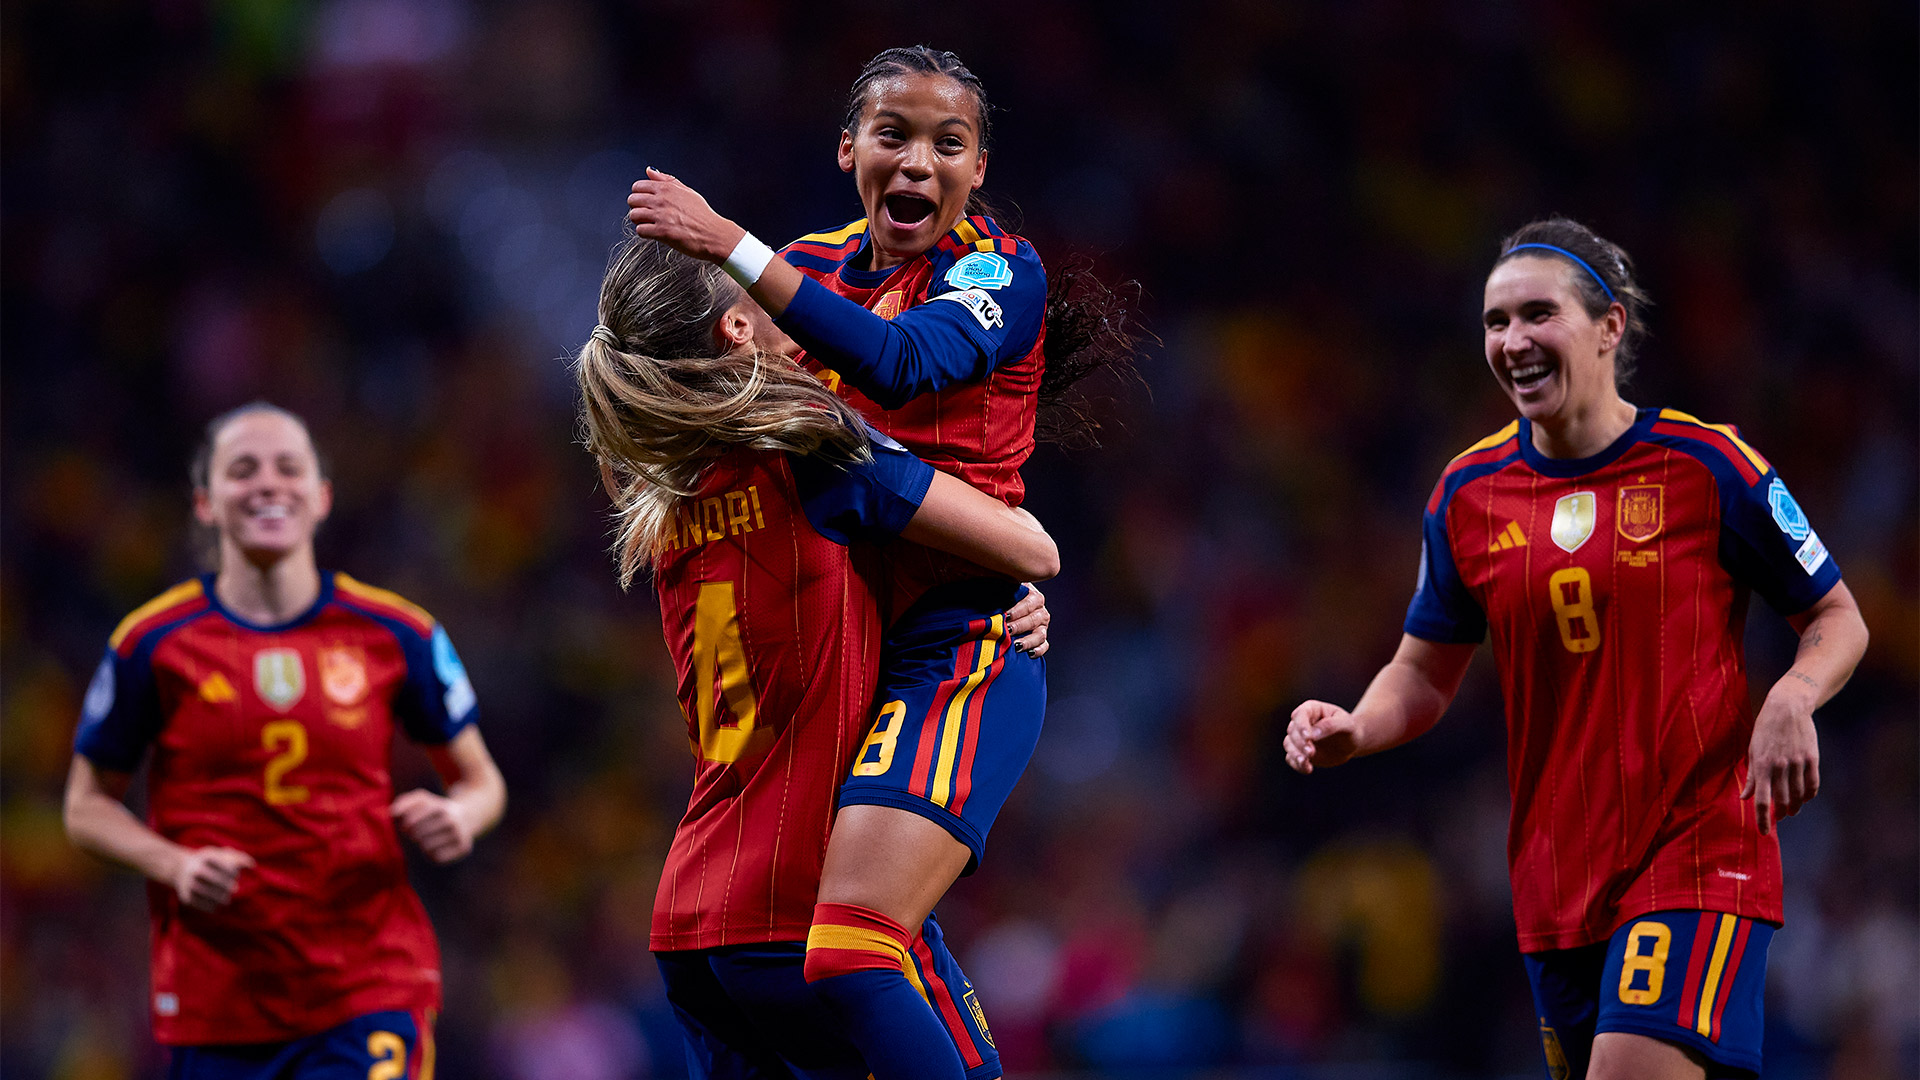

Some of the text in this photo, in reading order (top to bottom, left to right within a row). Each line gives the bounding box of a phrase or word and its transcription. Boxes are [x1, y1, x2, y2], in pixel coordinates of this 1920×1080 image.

[664, 485, 766, 552] ANDRI
[1548, 566, 1601, 653] 8
[692, 580, 774, 764] 4
[261, 719, 309, 806] 2
[852, 699, 907, 777] 8
[1618, 920, 1672, 1006] 8
[366, 1029, 406, 1080] 2
